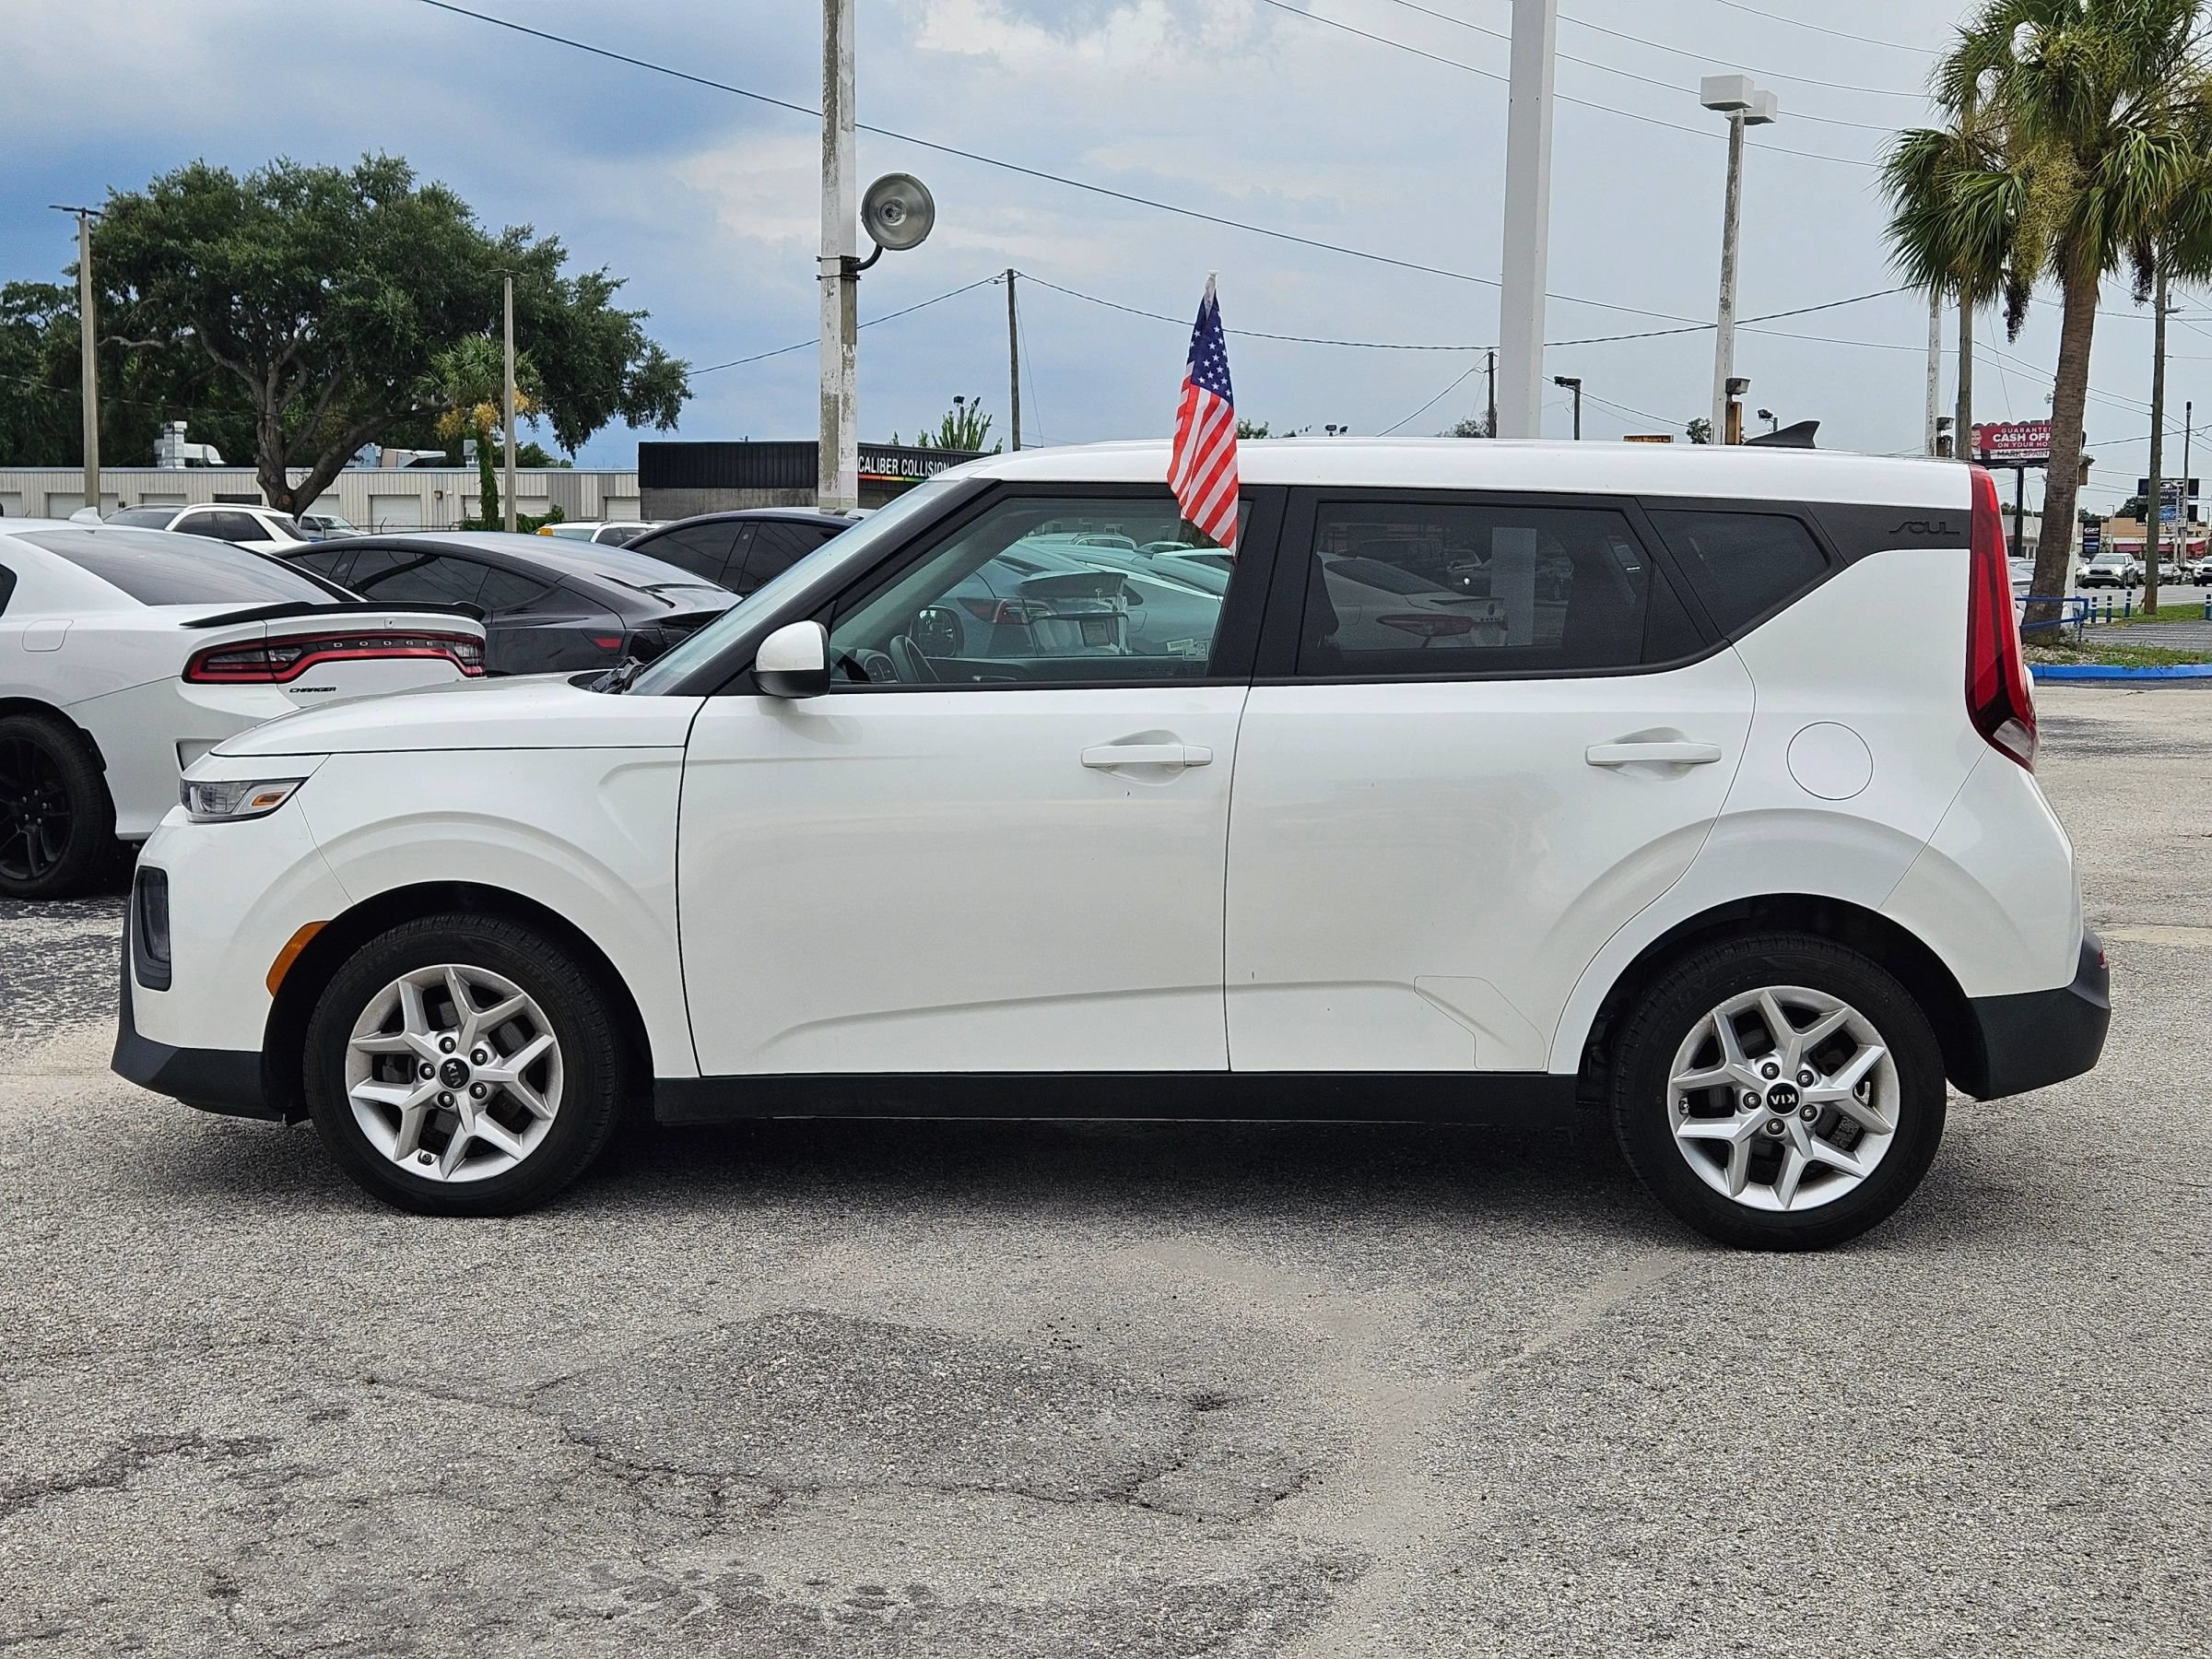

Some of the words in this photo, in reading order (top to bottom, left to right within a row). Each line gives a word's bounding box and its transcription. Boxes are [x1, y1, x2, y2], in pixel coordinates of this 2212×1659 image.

[1993, 432, 2026, 442] CASH
[858, 455, 899, 475] CALIBER
[1888, 522, 1960, 535] SOUL
[446, 1062, 462, 1087] KIA
[1770, 1093, 1796, 1105] KIA
